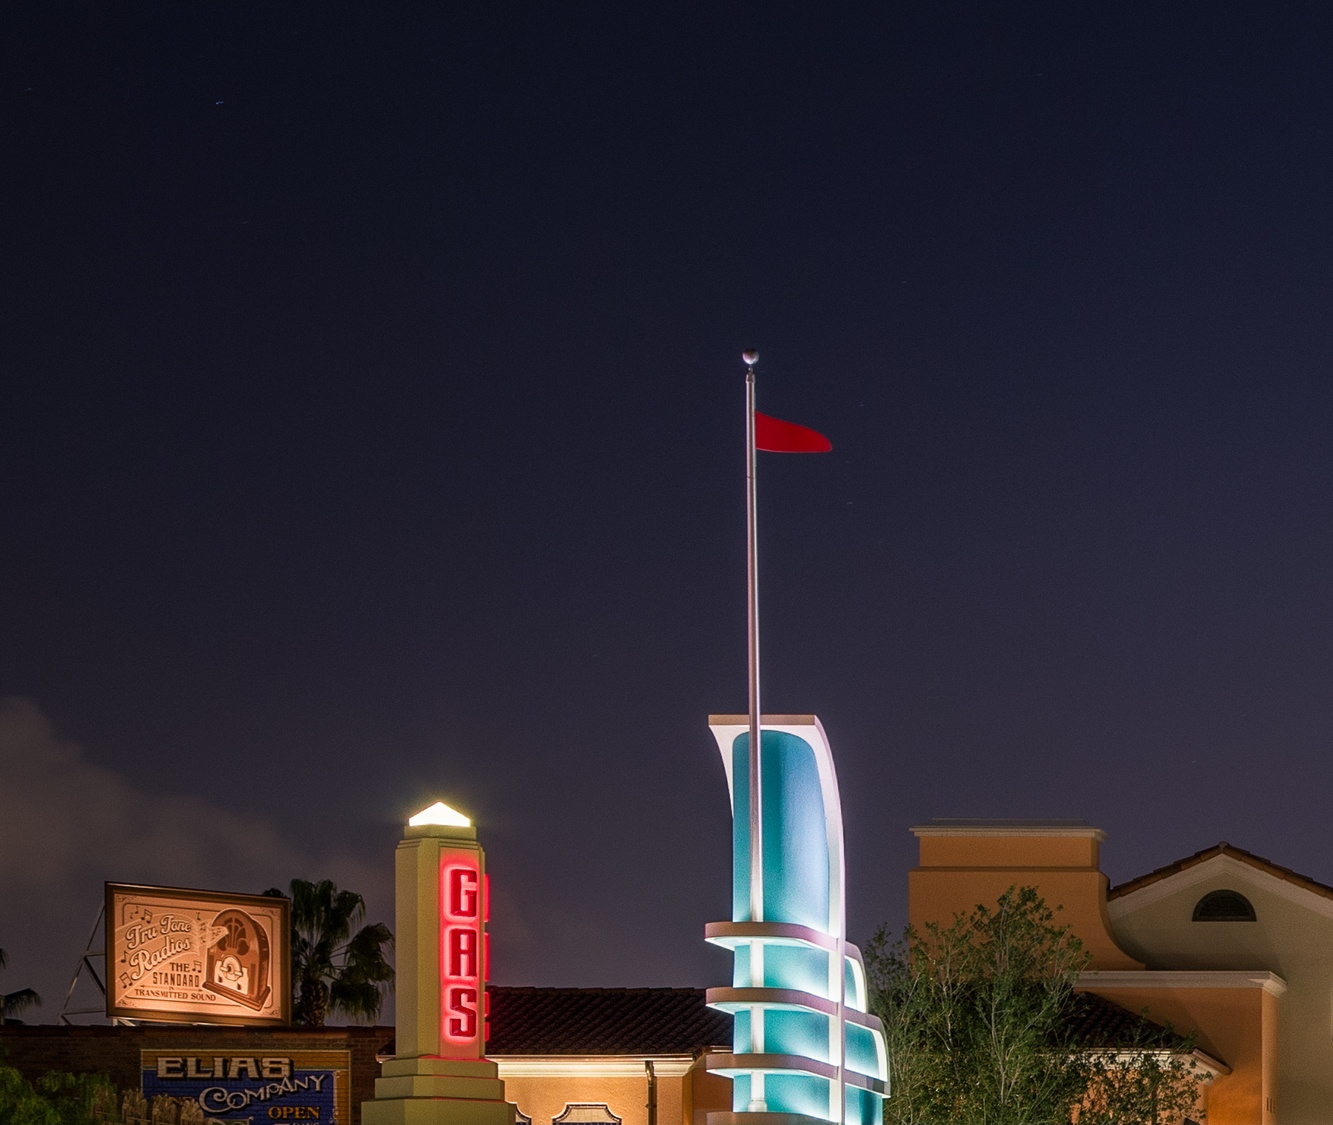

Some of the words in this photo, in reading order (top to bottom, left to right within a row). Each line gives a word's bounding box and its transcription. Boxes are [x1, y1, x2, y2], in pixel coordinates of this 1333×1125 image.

[125, 924, 157, 949] Tru
[160, 914, 191, 935] Tone
[129, 936, 191, 980] Radios
[449, 868, 477, 1038] GAS
[170, 962, 190, 972] THE
[152, 971, 200, 988] STANDARD
[134, 988, 189, 999] TRANSMITTED
[191, 993, 216, 1001] SOUND
[156, 1057, 292, 1079] ELIAS
[267, 1106, 320, 1119] OPEN
